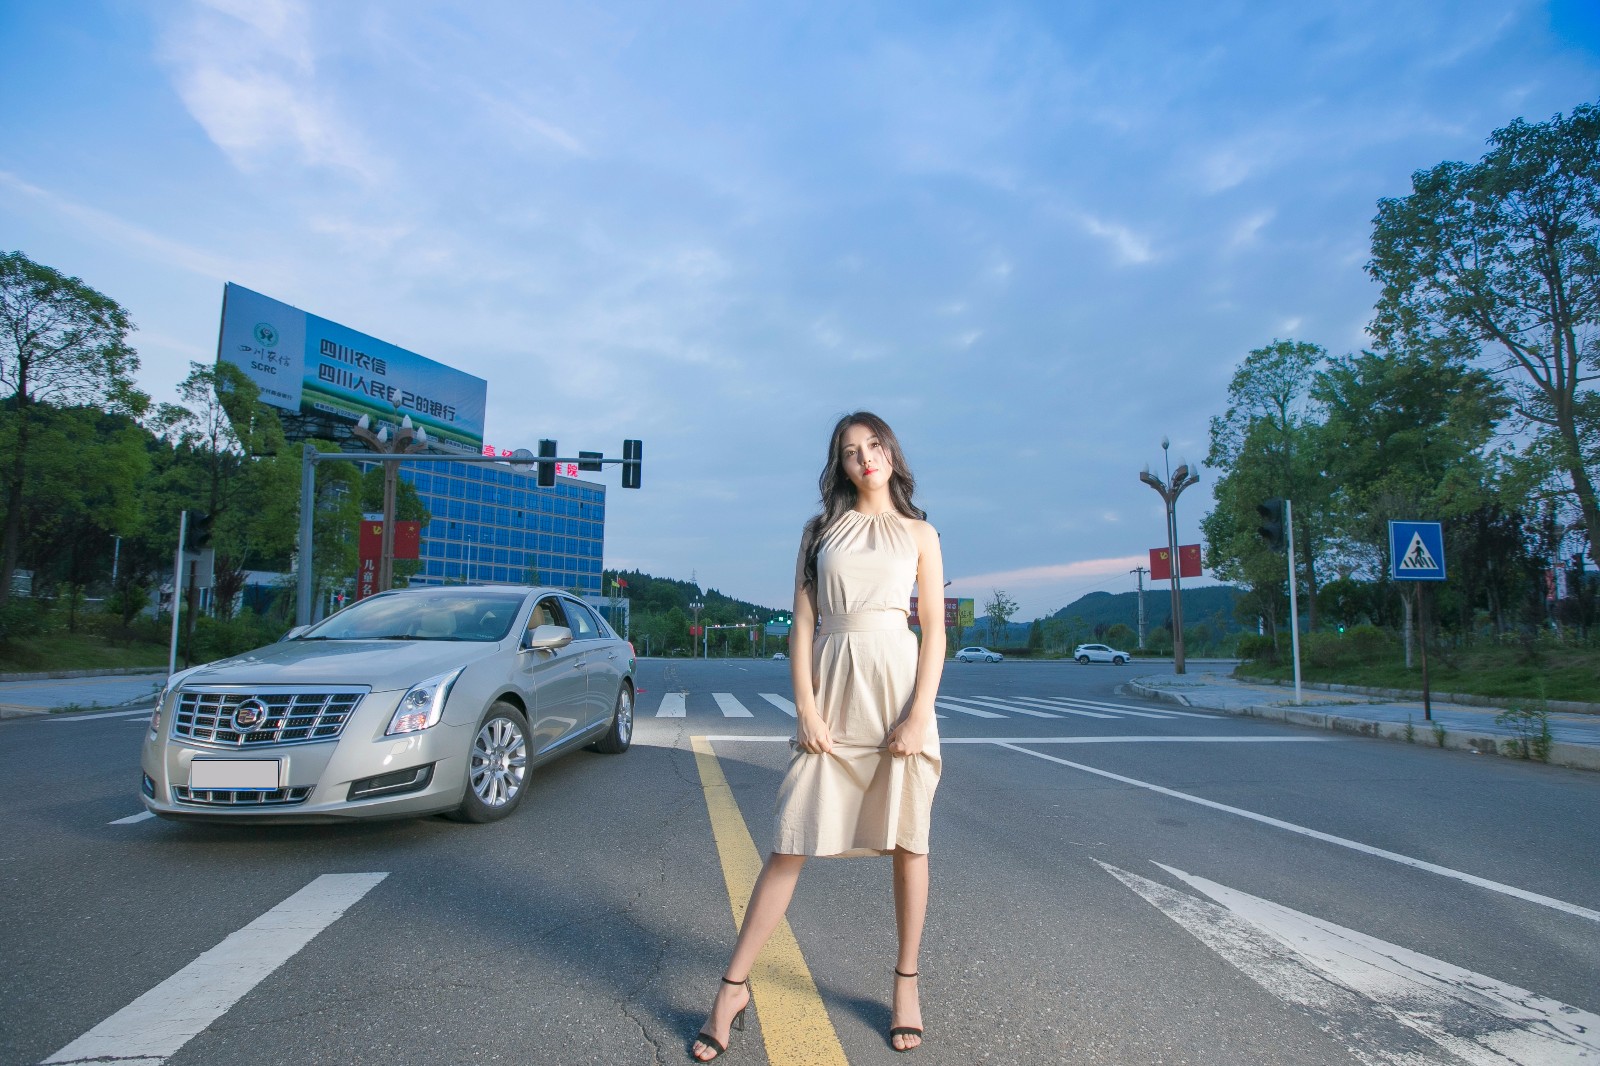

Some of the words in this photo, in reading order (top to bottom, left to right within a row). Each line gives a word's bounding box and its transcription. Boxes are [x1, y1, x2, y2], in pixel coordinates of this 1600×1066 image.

[251, 360, 277, 375] SCRC
[320, 338, 387, 376] 四川农信
[362, 559, 374, 599] 儿童名
